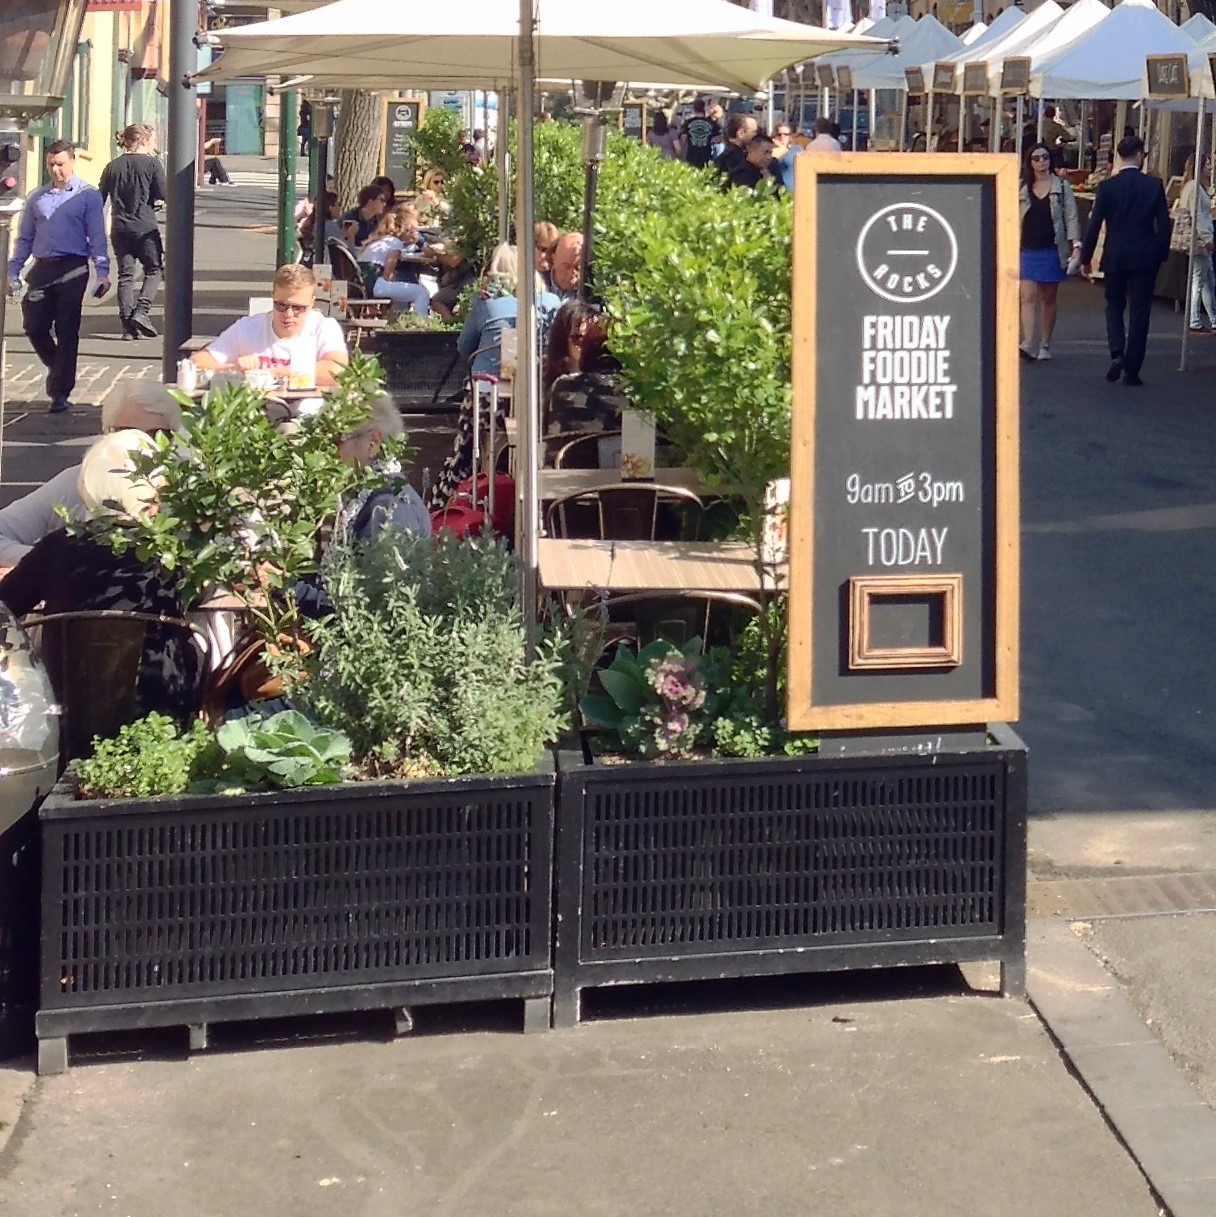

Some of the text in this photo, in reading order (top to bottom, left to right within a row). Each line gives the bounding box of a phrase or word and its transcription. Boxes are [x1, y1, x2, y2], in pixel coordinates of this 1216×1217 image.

[886, 214, 928, 232] THE
[872, 264, 942, 293] ROCKS
[863, 315, 951, 349] FRIDAY
[862, 350, 951, 384] FOODIE
[856, 384, 958, 420] MARKET
[846, 473, 894, 504] 9am
[919, 472, 964, 507] 3pm
[861, 527, 948, 566] TODAY
